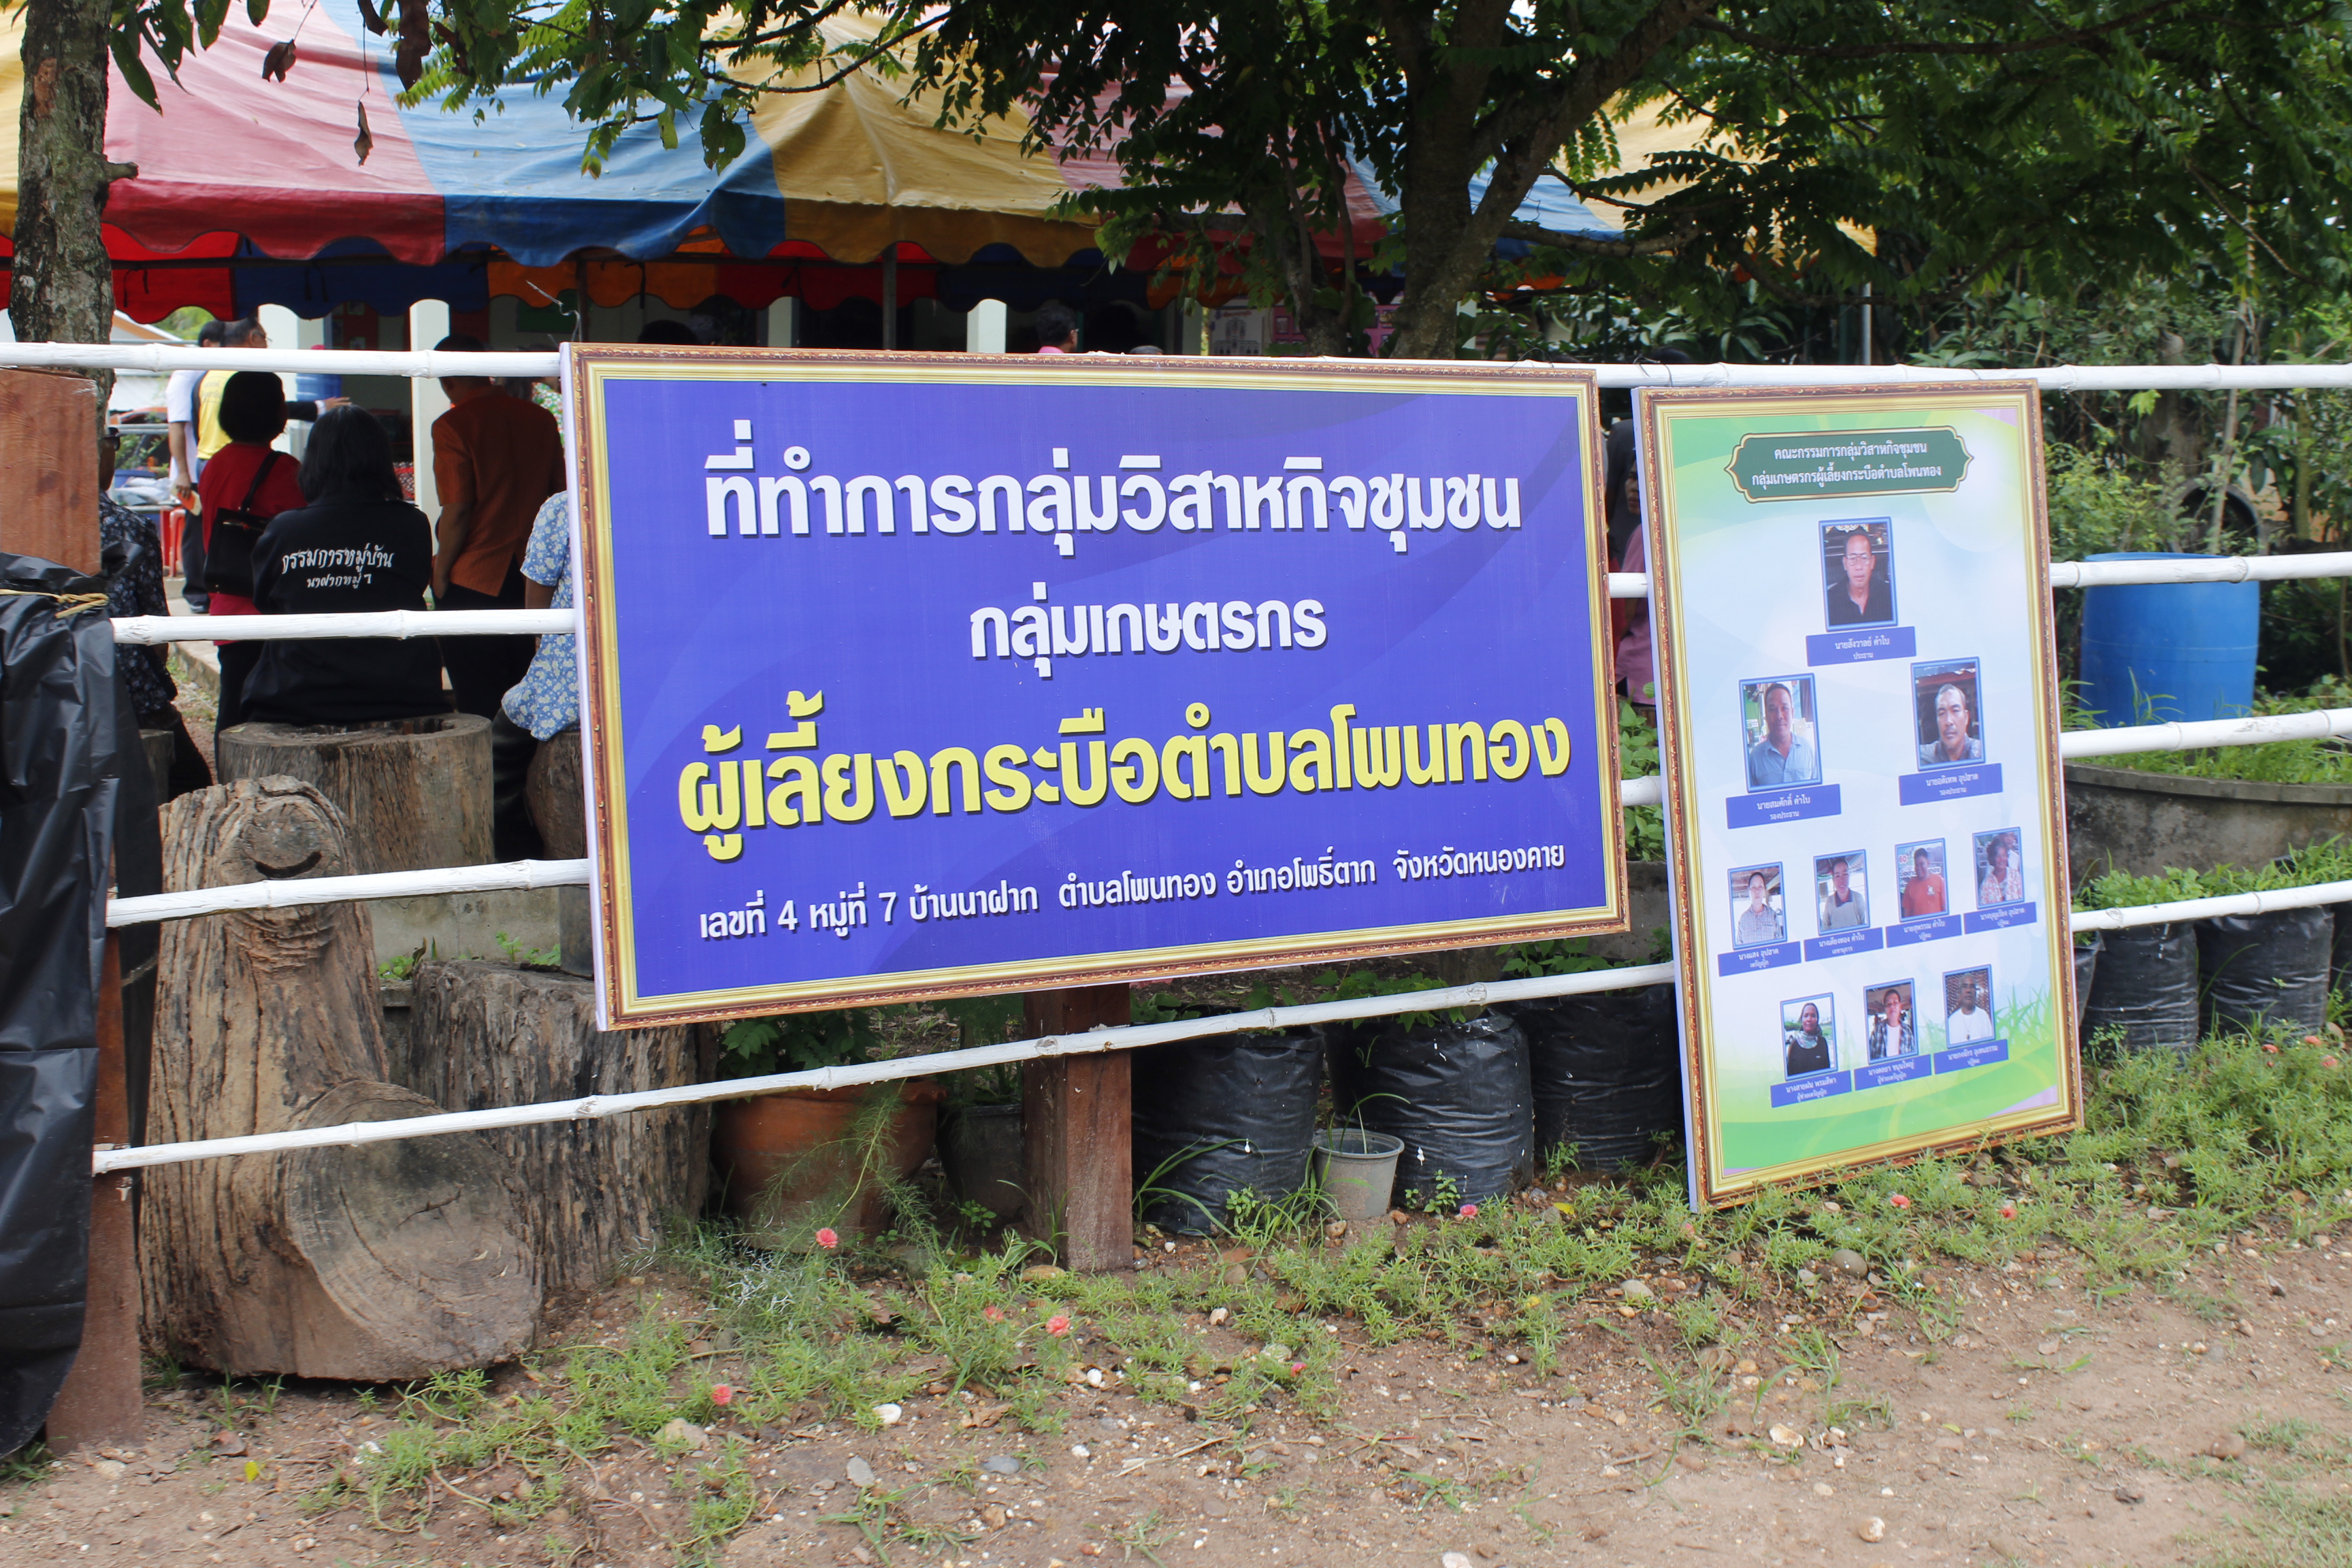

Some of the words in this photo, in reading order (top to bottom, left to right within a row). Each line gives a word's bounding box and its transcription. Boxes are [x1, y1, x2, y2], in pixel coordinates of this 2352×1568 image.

[704, 420, 1522, 556] ที่ทำการกลุ่มวิสาหกิจชุมชน
[1752, 461, 1942, 489] กลุ่มเกษตรกรผู้เลี้ยงกระบือตำบลโพนทอง
[1774, 440, 1927, 461] คณะกรรมการกลุ่มวิสาหกิจชุมชน
[282, 543, 395, 574] กรรมการหมู่บ้าน
[970, 582, 1327, 677] กลุ่มเกษตรกร
[678, 690, 1571, 860] ผู้เลี้ยงกระบือตำบลโพนทอง
[700, 889, 766, 938] เลขที่
[777, 900, 798, 931] 4
[810, 882, 867, 937] หมู่ที่
[879, 892, 898, 922] 7
[909, 883, 1039, 921] บ้านนาฝาก
[1058, 870, 1216, 909] ตำบลโพนทอง
[1227, 846, 1376, 894] อำเภอโพธิ์ตาก
[1392, 844, 1565, 881] จังหวัดหนองคาย
